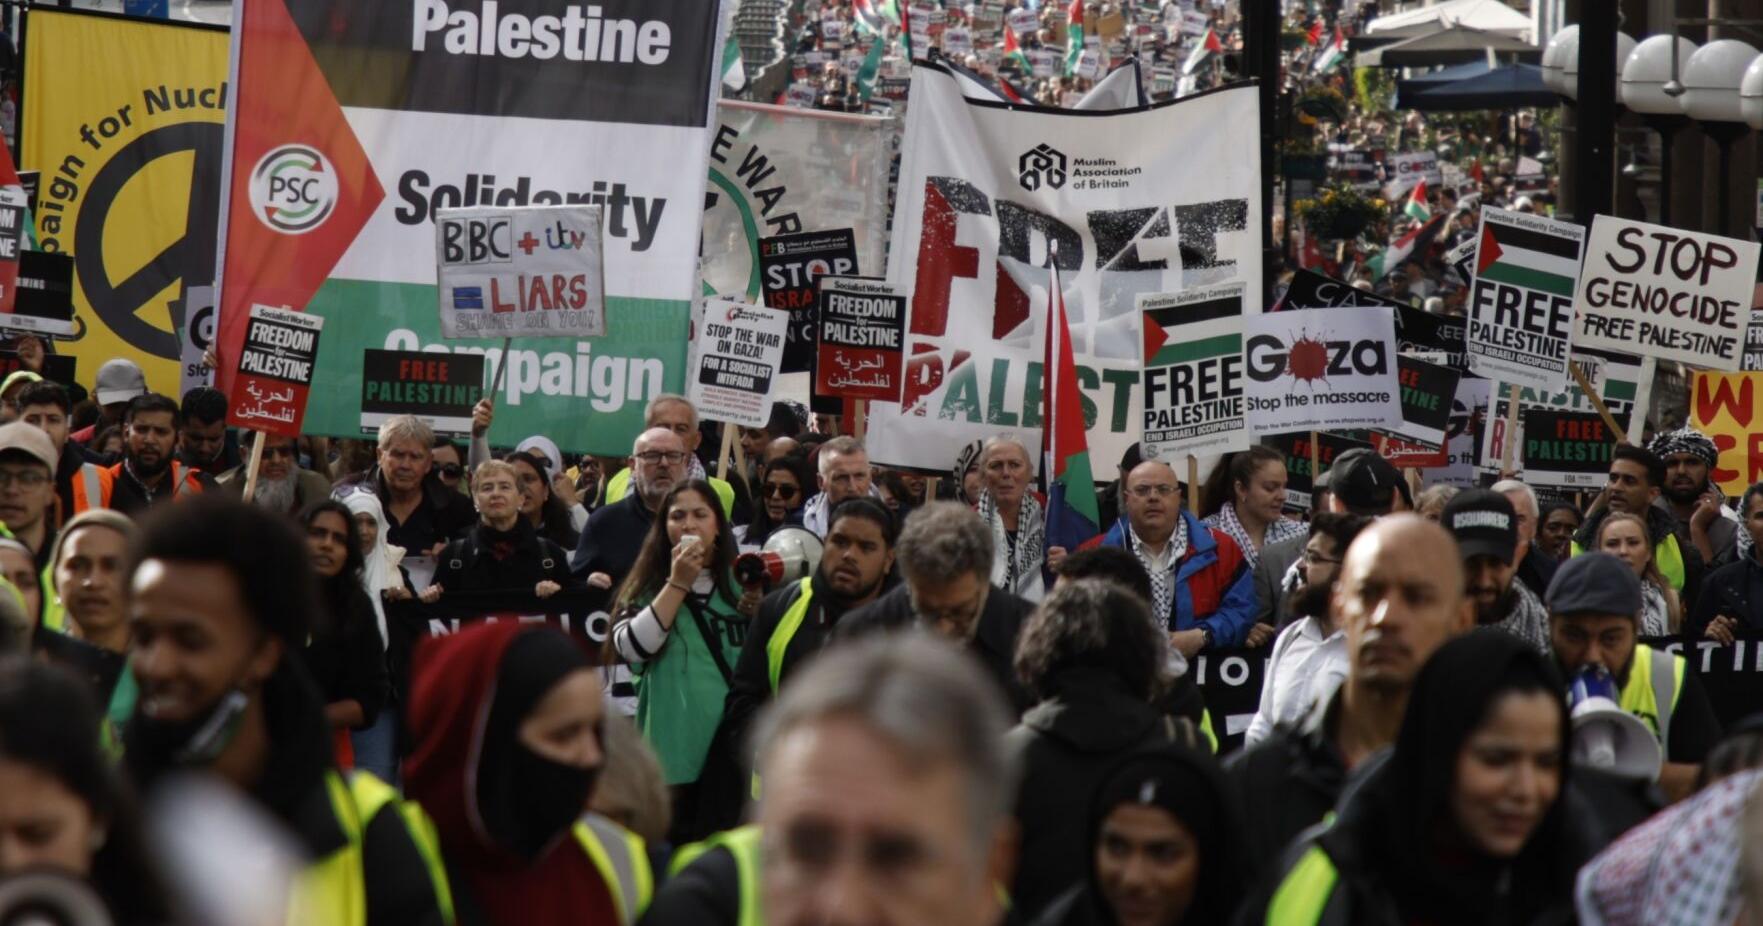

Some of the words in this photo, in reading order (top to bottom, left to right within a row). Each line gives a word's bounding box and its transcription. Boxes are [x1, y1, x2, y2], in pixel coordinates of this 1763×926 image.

[412, 0, 671, 65] Palestine
[79, 104, 132, 150] for
[1073, 158, 1116, 166] Muslim
[1073, 166, 1142, 178] Association
[269, 176, 321, 204] PSC
[736, 145, 802, 236] WAR
[1073, 180, 1086, 190] of
[1089, 179, 1130, 189] Britain
[394, 169, 667, 251] Solidity
[1484, 212, 1515, 225] Palestine
[1516, 218, 1548, 232] Solidarity
[1549, 225, 1582, 240] Campaign
[443, 220, 510, 263] BBC
[545, 220, 586, 250] itv
[1604, 226, 1738, 287] STOP
[768, 257, 853, 290] STOP
[490, 272, 588, 314] LIARS
[828, 293, 897, 319] FREEDOM
[1142, 297, 1176, 308] Palestine
[1177, 293, 1207, 304] Solidarity
[1208, 287, 1242, 298] Campaign
[1585, 276, 1741, 330] GENOCIDE
[456, 312, 514, 332] SHAME
[526, 312, 550, 329] ON
[856, 316, 868, 326] for
[1471, 279, 1573, 340] FREE
[250, 321, 315, 353] FREEDOM
[706, 323, 732, 340] STOP
[735, 327, 754, 343] THE
[756, 332, 780, 348] WAR
[823, 321, 899, 348] PALESTINE
[1469, 320, 1567, 360] PALESTINE
[1583, 312, 1635, 340] FREE
[1637, 321, 1738, 360] PALESTINE
[274, 347, 287, 357] for
[717, 339, 731, 354] ON
[733, 342, 764, 360] GAZA!
[835, 350, 884, 371] الحرية
[1246, 333, 1387, 384] Gza
[1469, 342, 1485, 354] END
[1485, 346, 1515, 361] ISRAELI
[1516, 353, 1563, 372] OCCUPATION
[240, 350, 311, 382] PALESTINE
[384, 329, 664, 413] mpaign
[400, 359, 448, 382] FREE
[703, 356, 720, 370] FOR
[720, 359, 728, 371] A
[728, 361, 772, 379] SOCIALIST
[246, 380, 294, 403] الحرية
[366, 381, 479, 406] PALESTINE
[716, 372, 755, 389] INTIFADA
[827, 371, 891, 389] لفلسطين
[1144, 355, 1243, 410] FREE
[235, 401, 296, 424] لفلسطين
[1144, 397, 1243, 430] PALESTINE
[1248, 396, 1281, 412] Stop
[1285, 394, 1308, 407] the
[1313, 391, 1390, 405] massacre
[1146, 432, 1164, 442] END
[1165, 427, 1196, 441] ISRAELI
[1197, 418, 1243, 436] OCCUPATION
[1556, 419, 1605, 441] FREE
